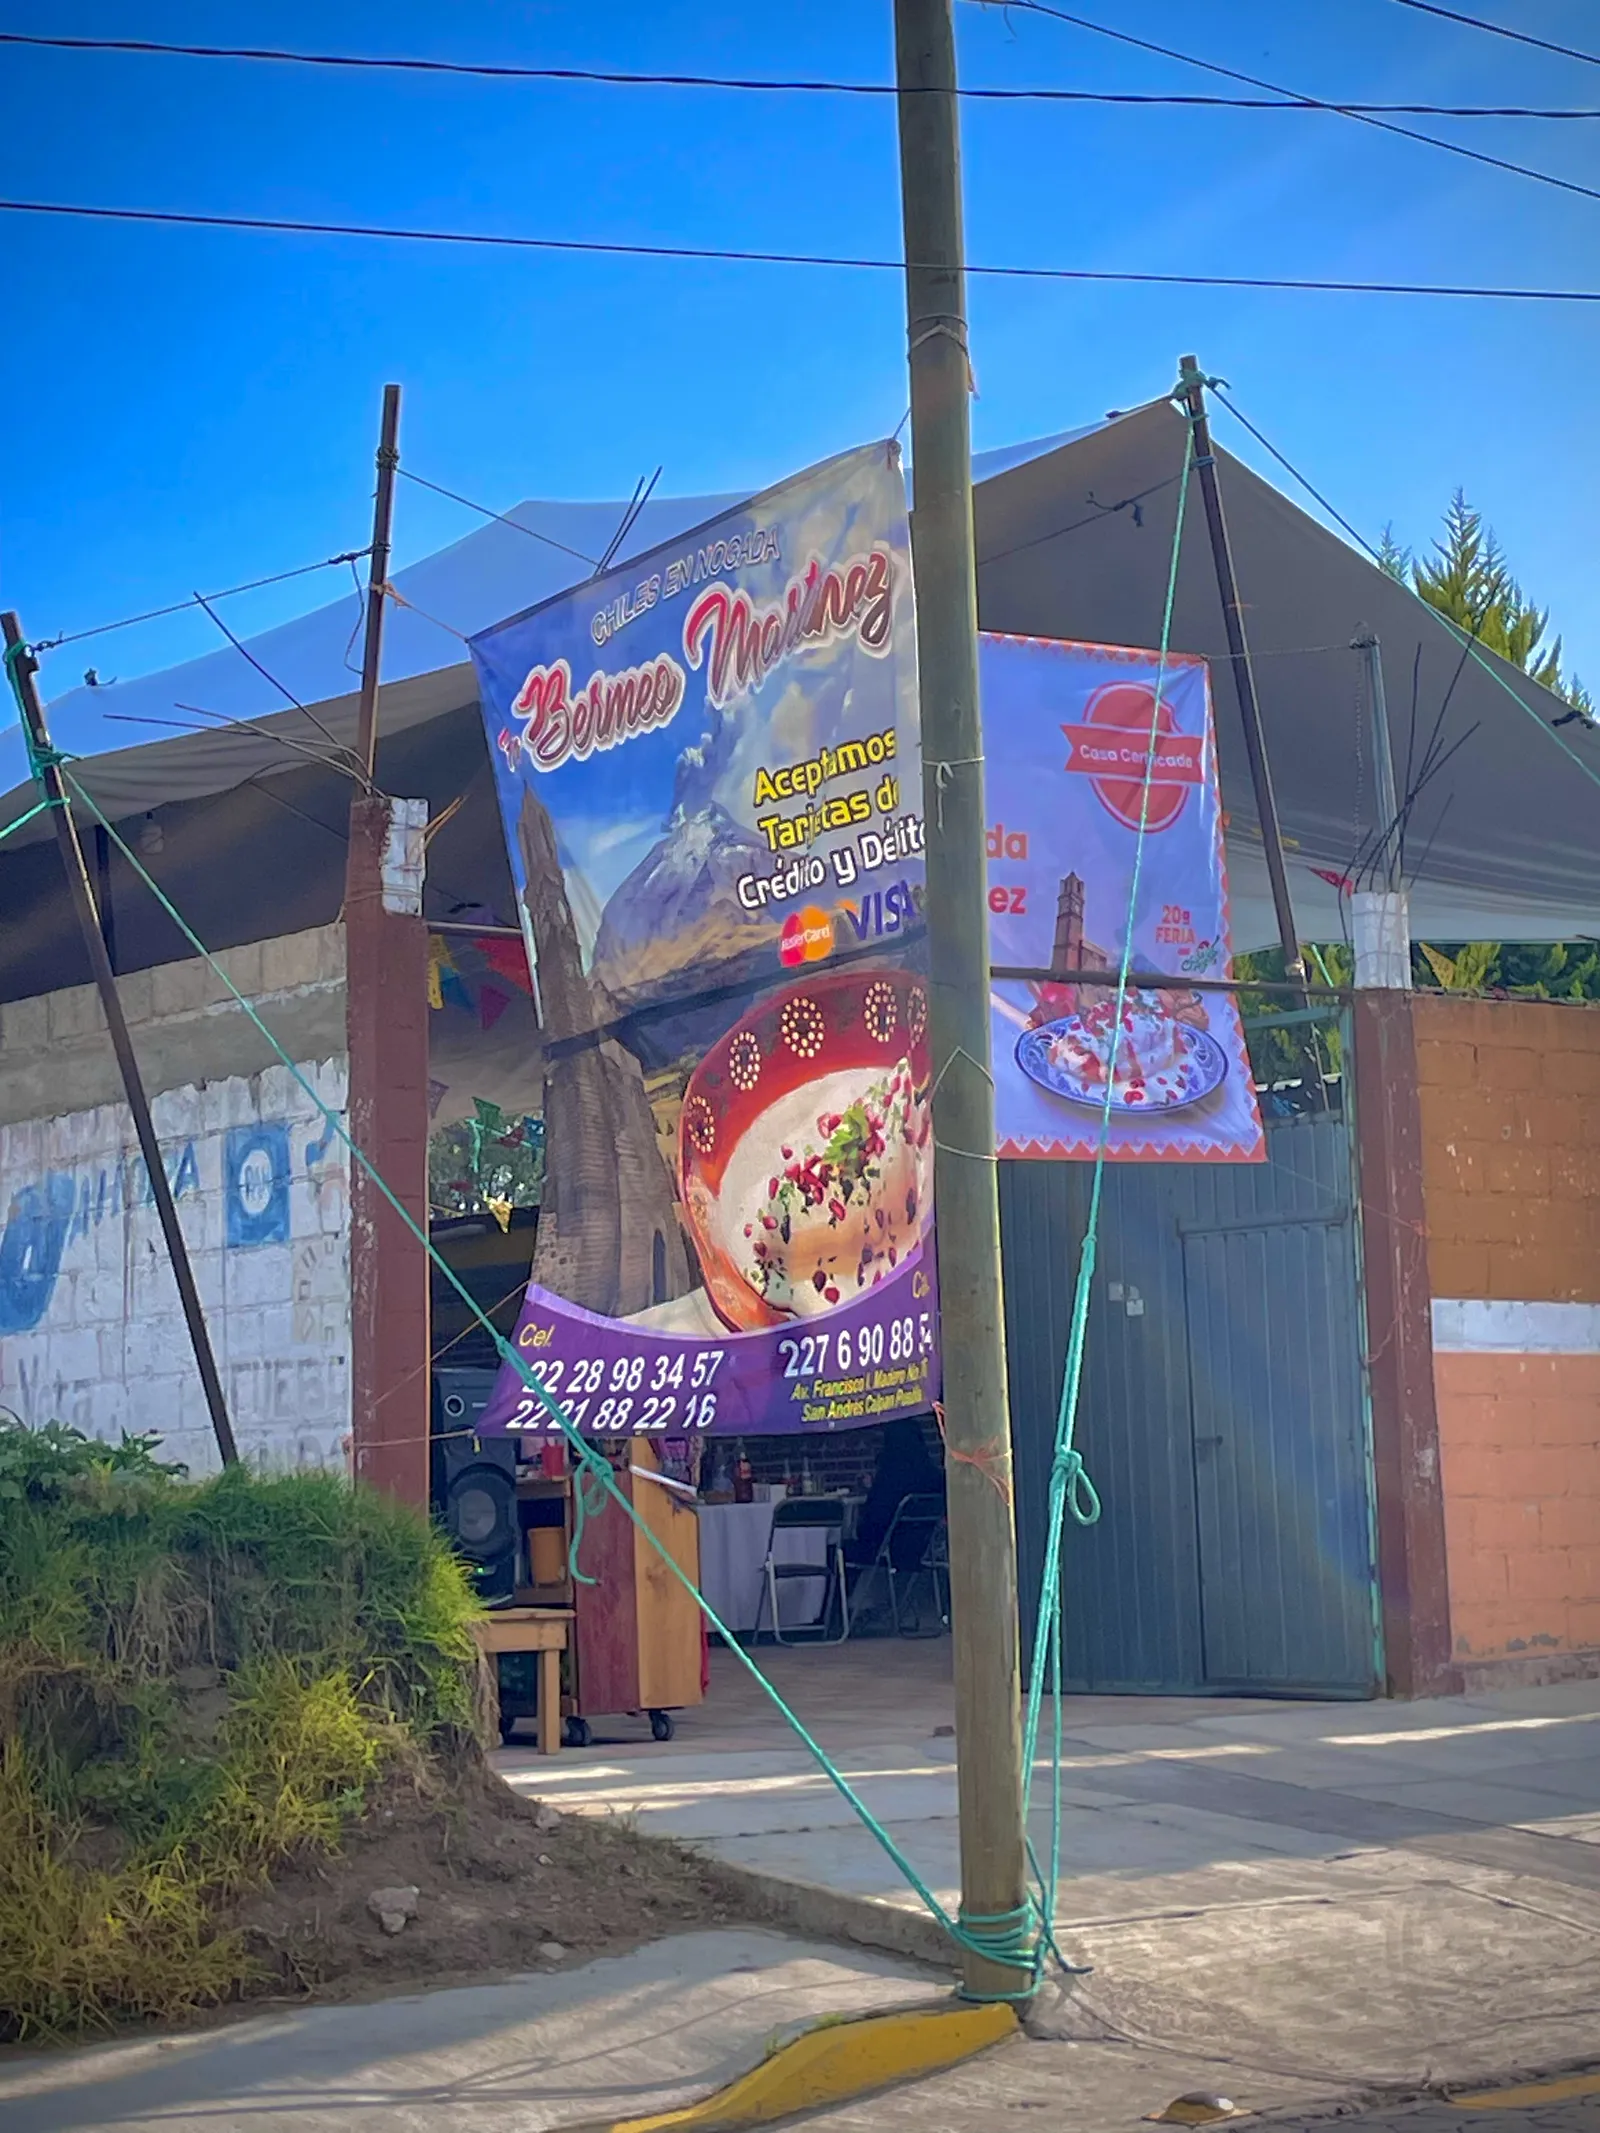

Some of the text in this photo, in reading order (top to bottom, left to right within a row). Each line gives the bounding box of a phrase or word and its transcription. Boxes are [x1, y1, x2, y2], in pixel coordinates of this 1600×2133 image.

[591, 524, 781, 648] CHILES EN NOGADA
[1080, 744, 1119, 761] Casa
[831, 848, 857, 888] y
[1155, 925, 1196, 945] FERIA
[778, 1333, 830, 1378] 227
[837, 1330, 851, 1370] 6
[858, 1323, 884, 1367] 90
[889, 1317, 914, 1361] 88
[521, 1350, 724, 1394] 22 28 98 34 57
[505, 1399, 550, 1430] 22
[592, 1397, 634, 1430] 88
[632, 1396, 677, 1430] 22
[682, 1393, 718, 1429] 16
